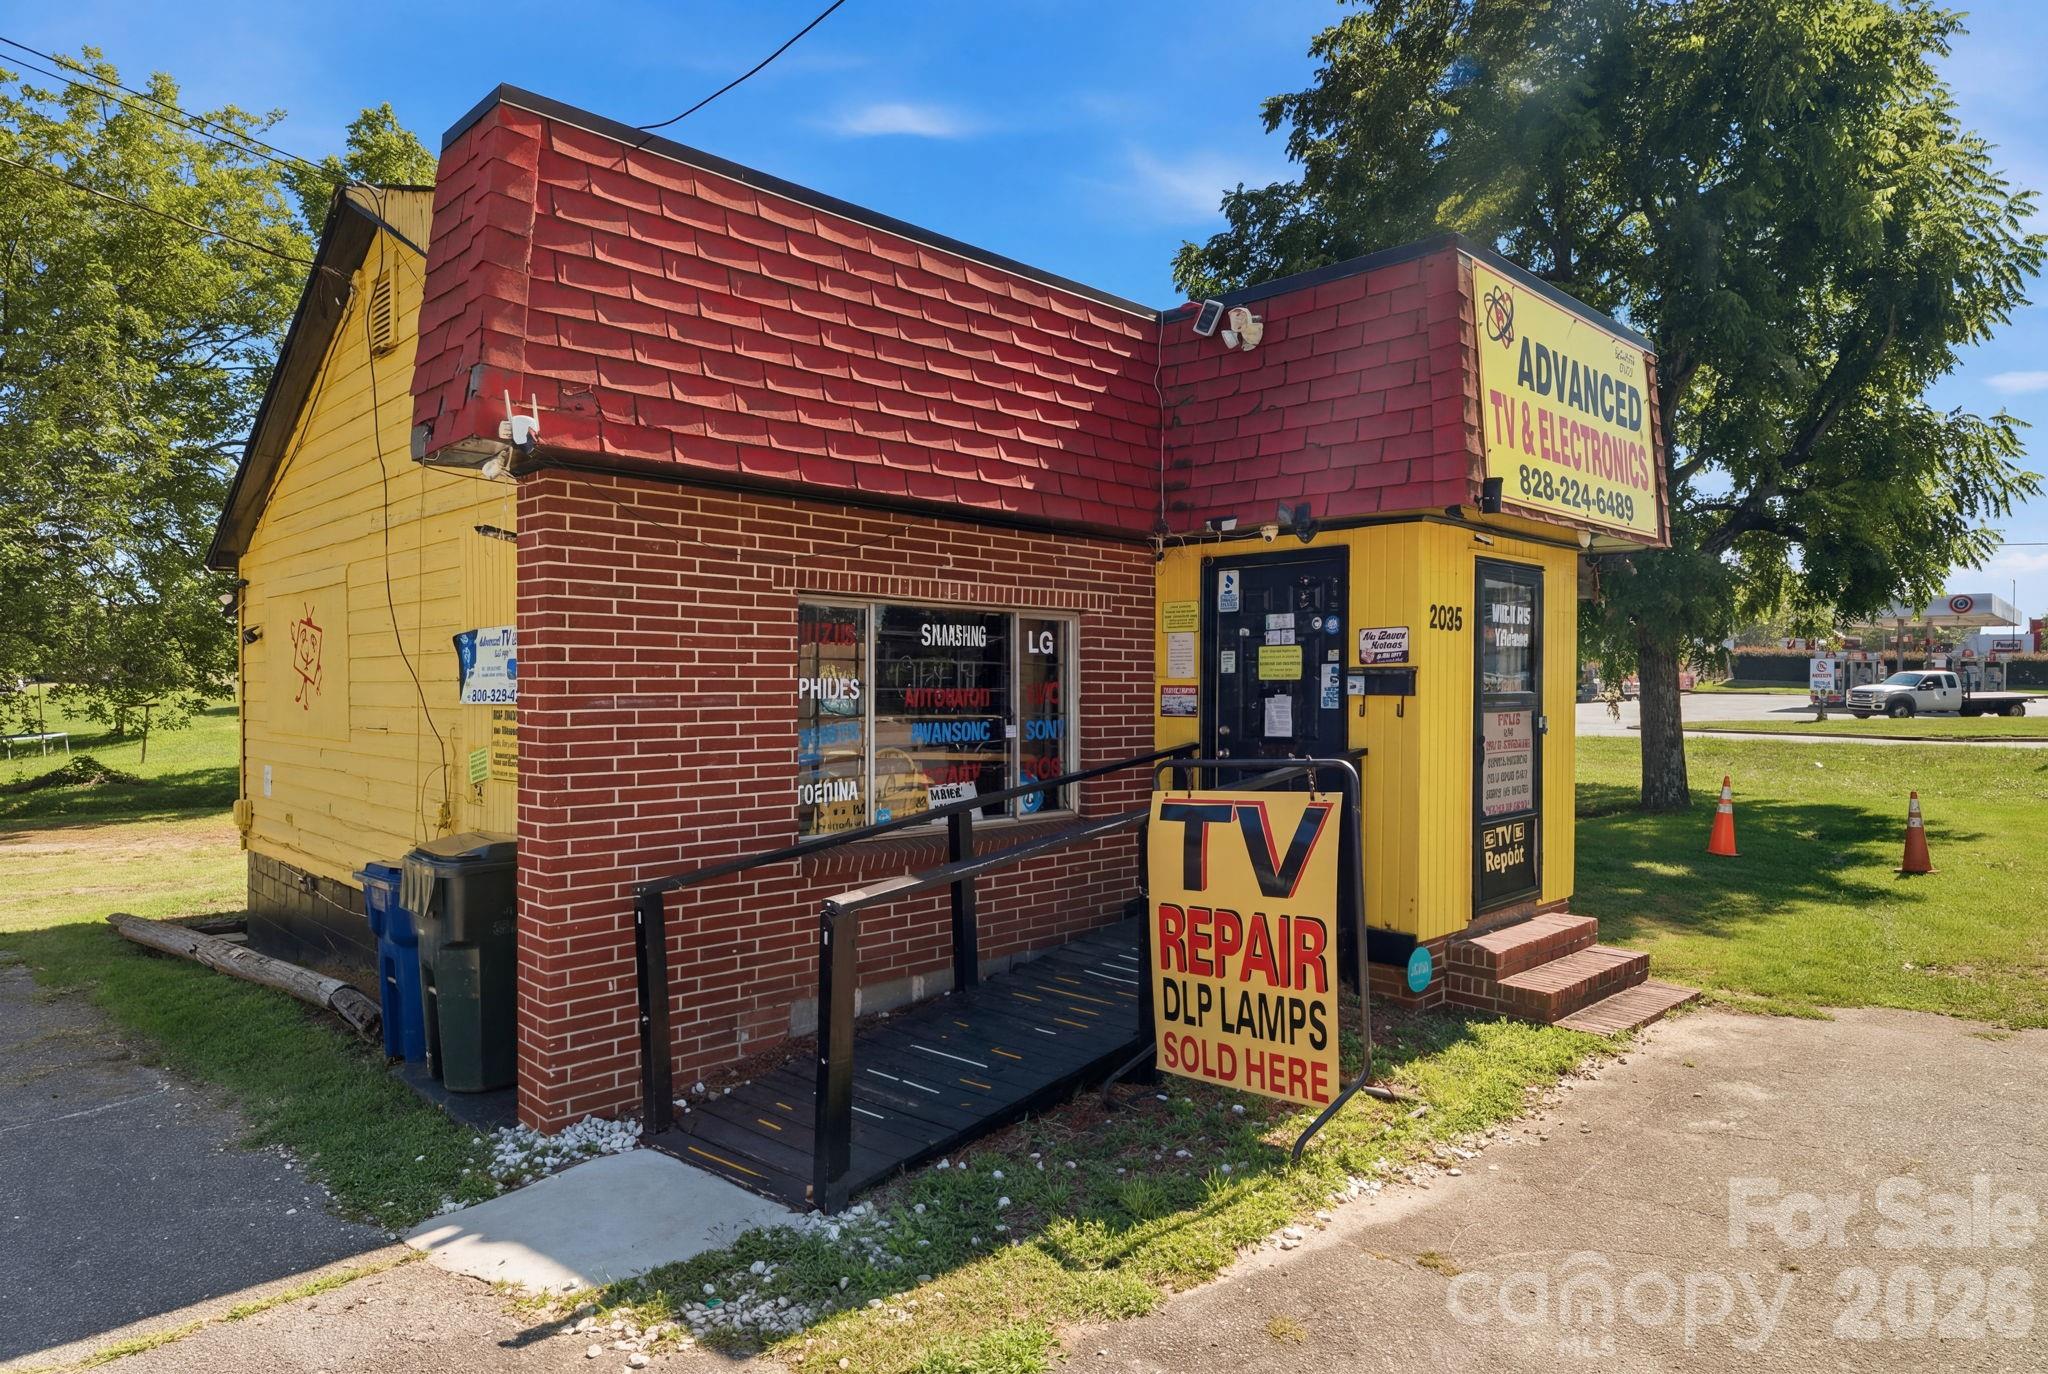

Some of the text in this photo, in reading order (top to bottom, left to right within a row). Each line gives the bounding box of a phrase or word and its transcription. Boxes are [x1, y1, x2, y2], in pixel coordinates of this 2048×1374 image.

[1518, 336, 1642, 432] ADVANCED
[1490, 389, 1649, 492] TV & ELECTRONICS
[1519, 464, 1634, 522] 828-224-6489
[502, 629, 512, 646] TV
[1028, 630, 1054, 655] LG
[1429, 603, 1463, 632] 2035
[1159, 798, 1334, 899] TV
[1496, 825, 1512, 847] TV
[1158, 903, 1328, 993] REPAIR
[1162, 977, 1328, 1051] DLP LAMPS
[1164, 1031, 1330, 1105] SOLD HERE
